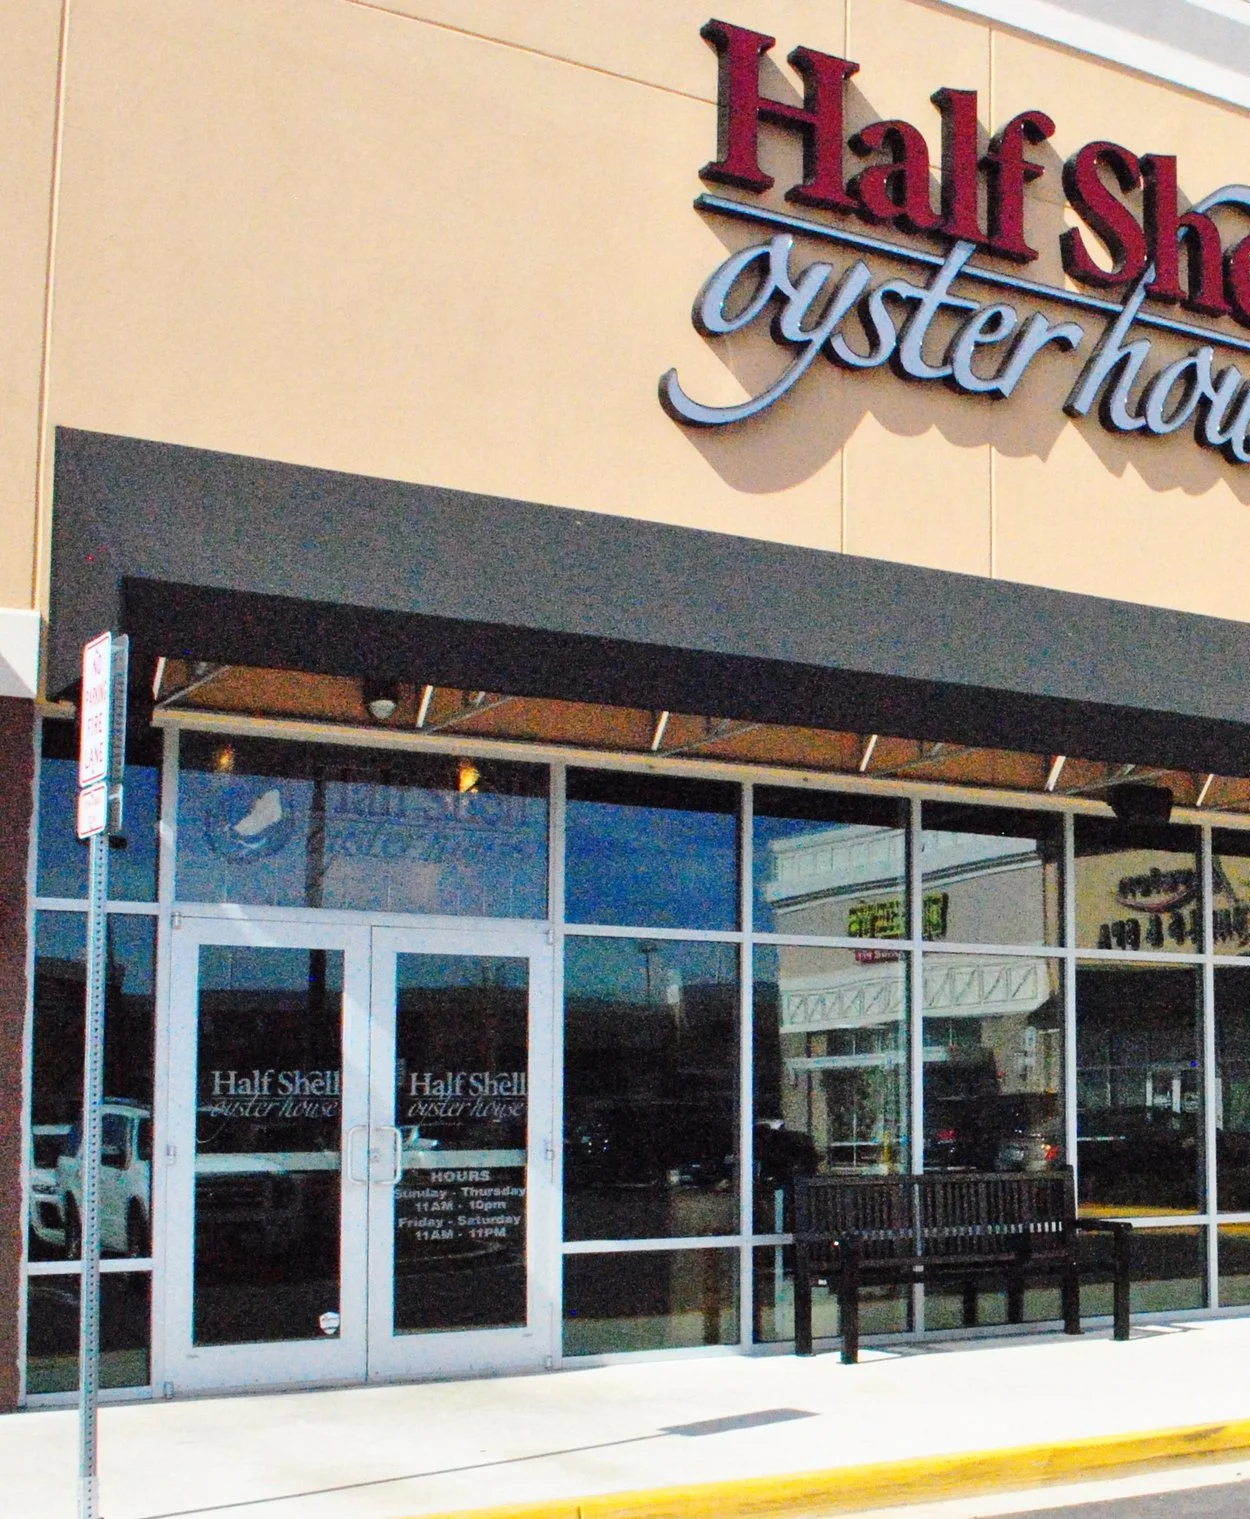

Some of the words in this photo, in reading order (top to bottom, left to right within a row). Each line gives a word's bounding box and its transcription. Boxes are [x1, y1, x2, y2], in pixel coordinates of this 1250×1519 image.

[699, 18, 1055, 263] Half
[659, 233, 1083, 427] oyster
[210, 1069, 275, 1095] Half
[277, 1069, 340, 1096] Shell
[410, 1072, 467, 1096] Half
[468, 1072, 528, 1096] Shell
[279, 1095, 341, 1118] house
[470, 1095, 524, 1119] house
[431, 1170, 490, 1183] HOURS
[395, 1188, 448, 1200] Sunday
[461, 1186, 526, 1198] Thursday
[415, 1201, 453, 1212] 11AM
[469, 1200, 506, 1212] 10pm
[398, 1217, 443, 1229] Friday
[457, 1215, 521, 1226] Saturday
[415, 1230, 454, 1240] 11AM
[469, 1227, 506, 1238] 11PM
